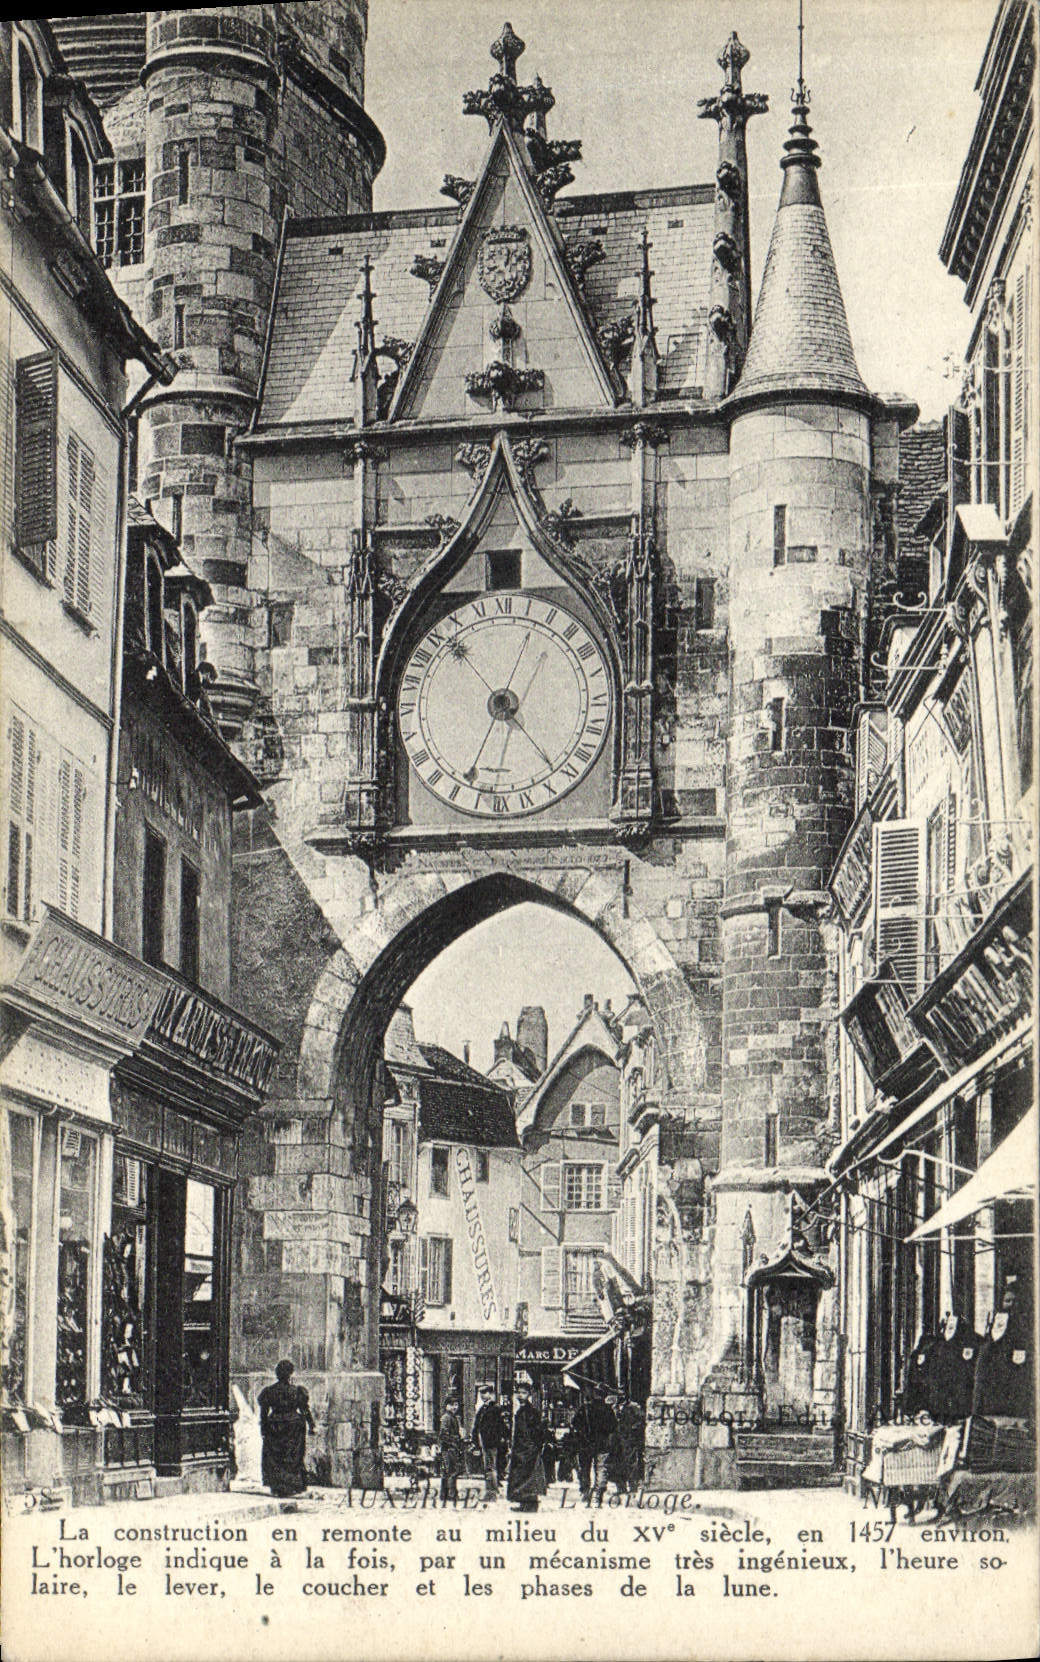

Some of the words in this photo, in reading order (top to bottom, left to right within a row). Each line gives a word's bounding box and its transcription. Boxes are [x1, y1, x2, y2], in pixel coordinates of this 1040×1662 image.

[472, 601, 487, 618] XI
[496, 597, 512, 614] XII
[525, 600, 532, 616] I
[450, 615, 464, 627] X
[545, 608, 557, 623] II
[562, 622, 579, 641] III
[457, 1148, 496, 1320] CHAUSSURES
